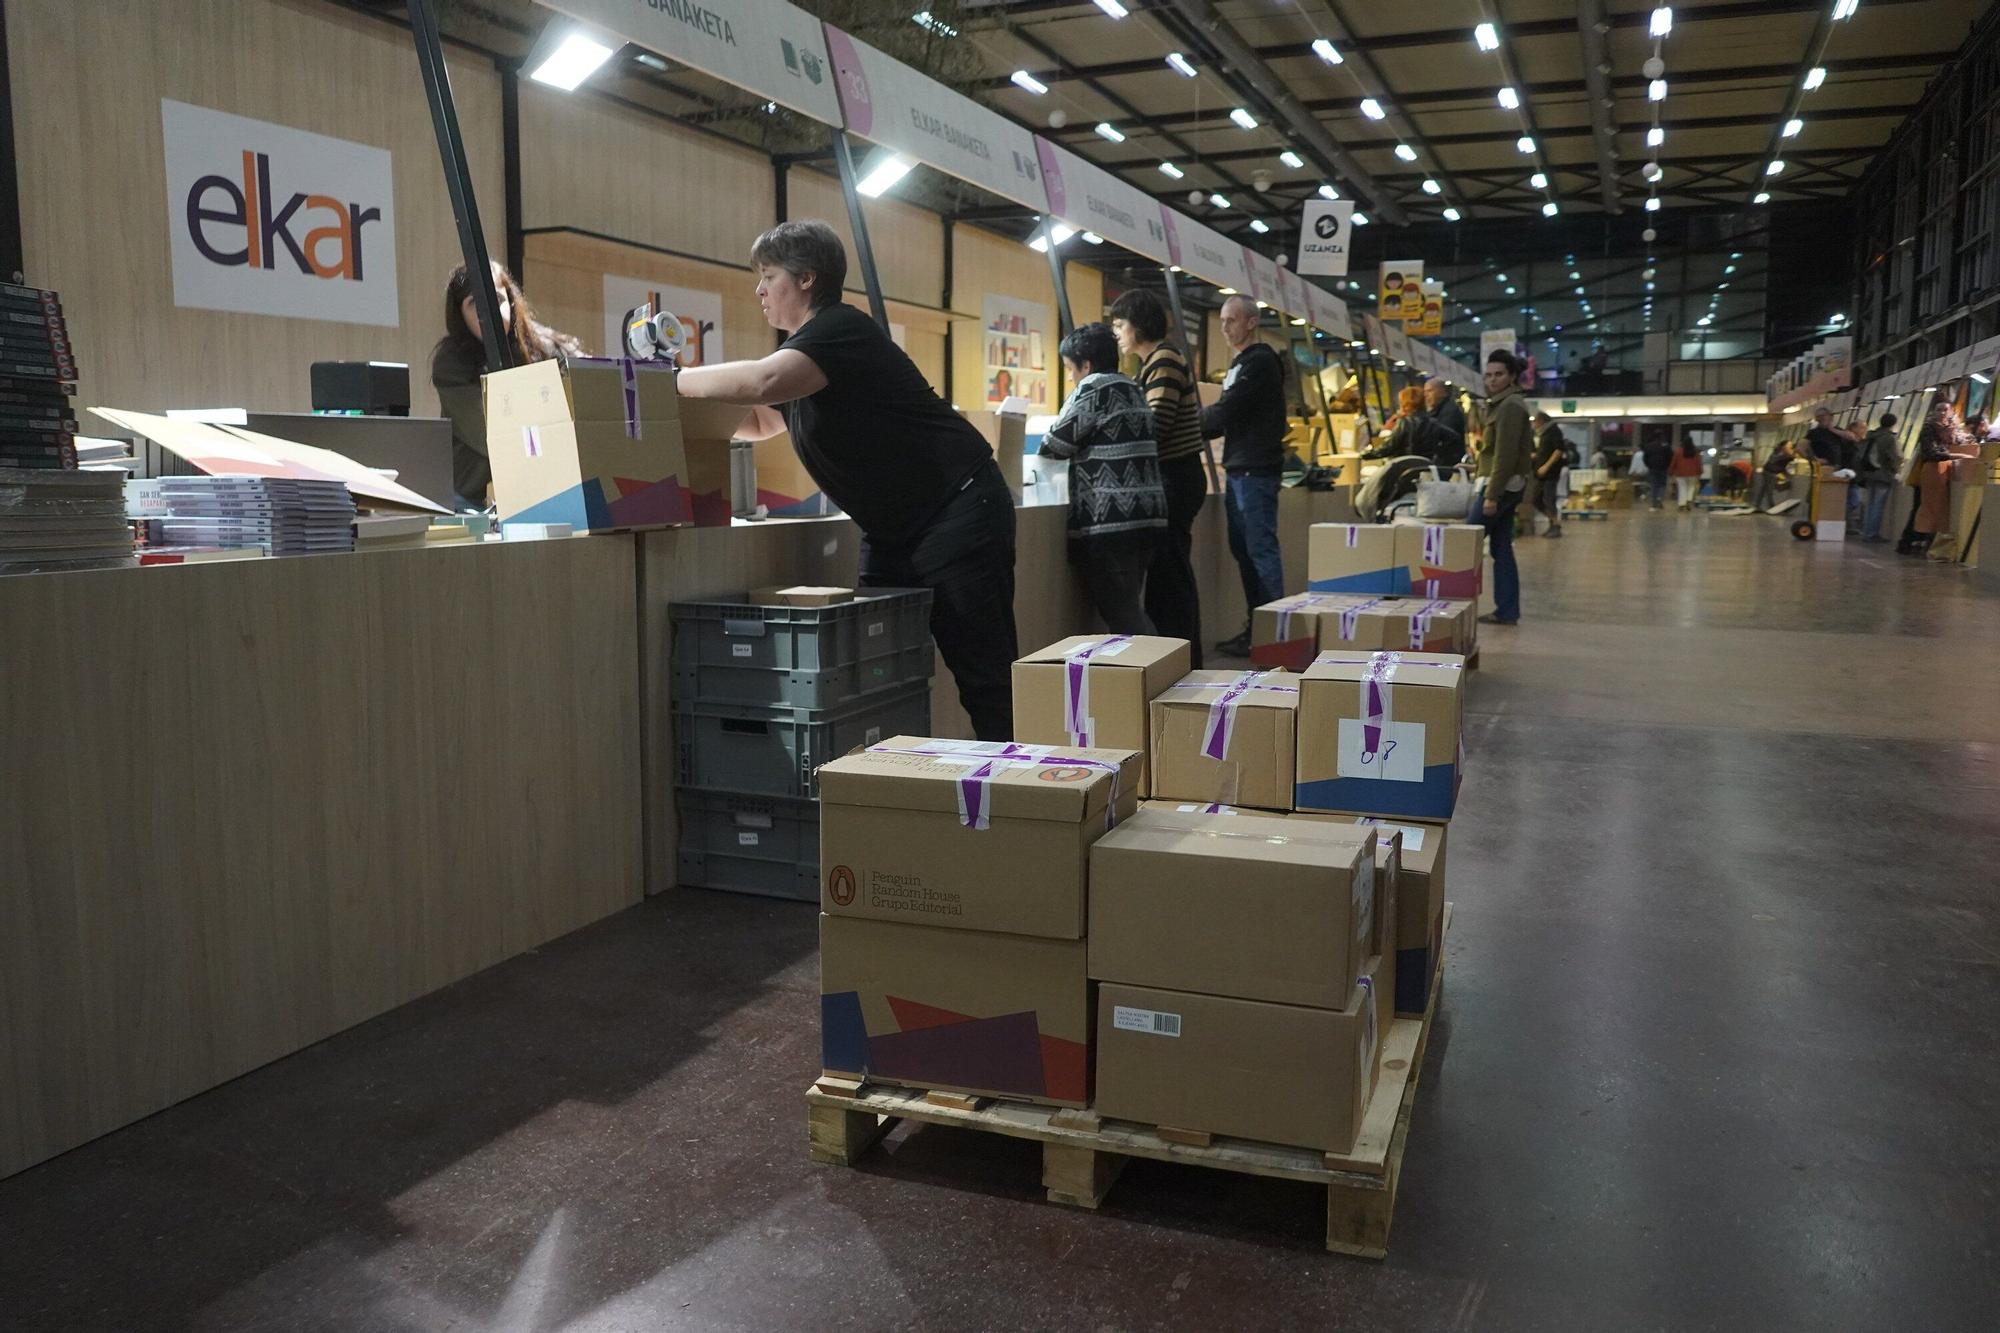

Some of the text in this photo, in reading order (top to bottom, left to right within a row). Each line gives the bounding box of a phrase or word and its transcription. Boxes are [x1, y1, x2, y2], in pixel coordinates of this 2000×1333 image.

[910, 107, 991, 160] ELKAR BANAKETA
[187, 150, 380, 281] elkar
[872, 870, 920, 886] Penguin
[872, 883, 960, 903] Random House
[872, 896, 962, 915] Grupo Editorial
